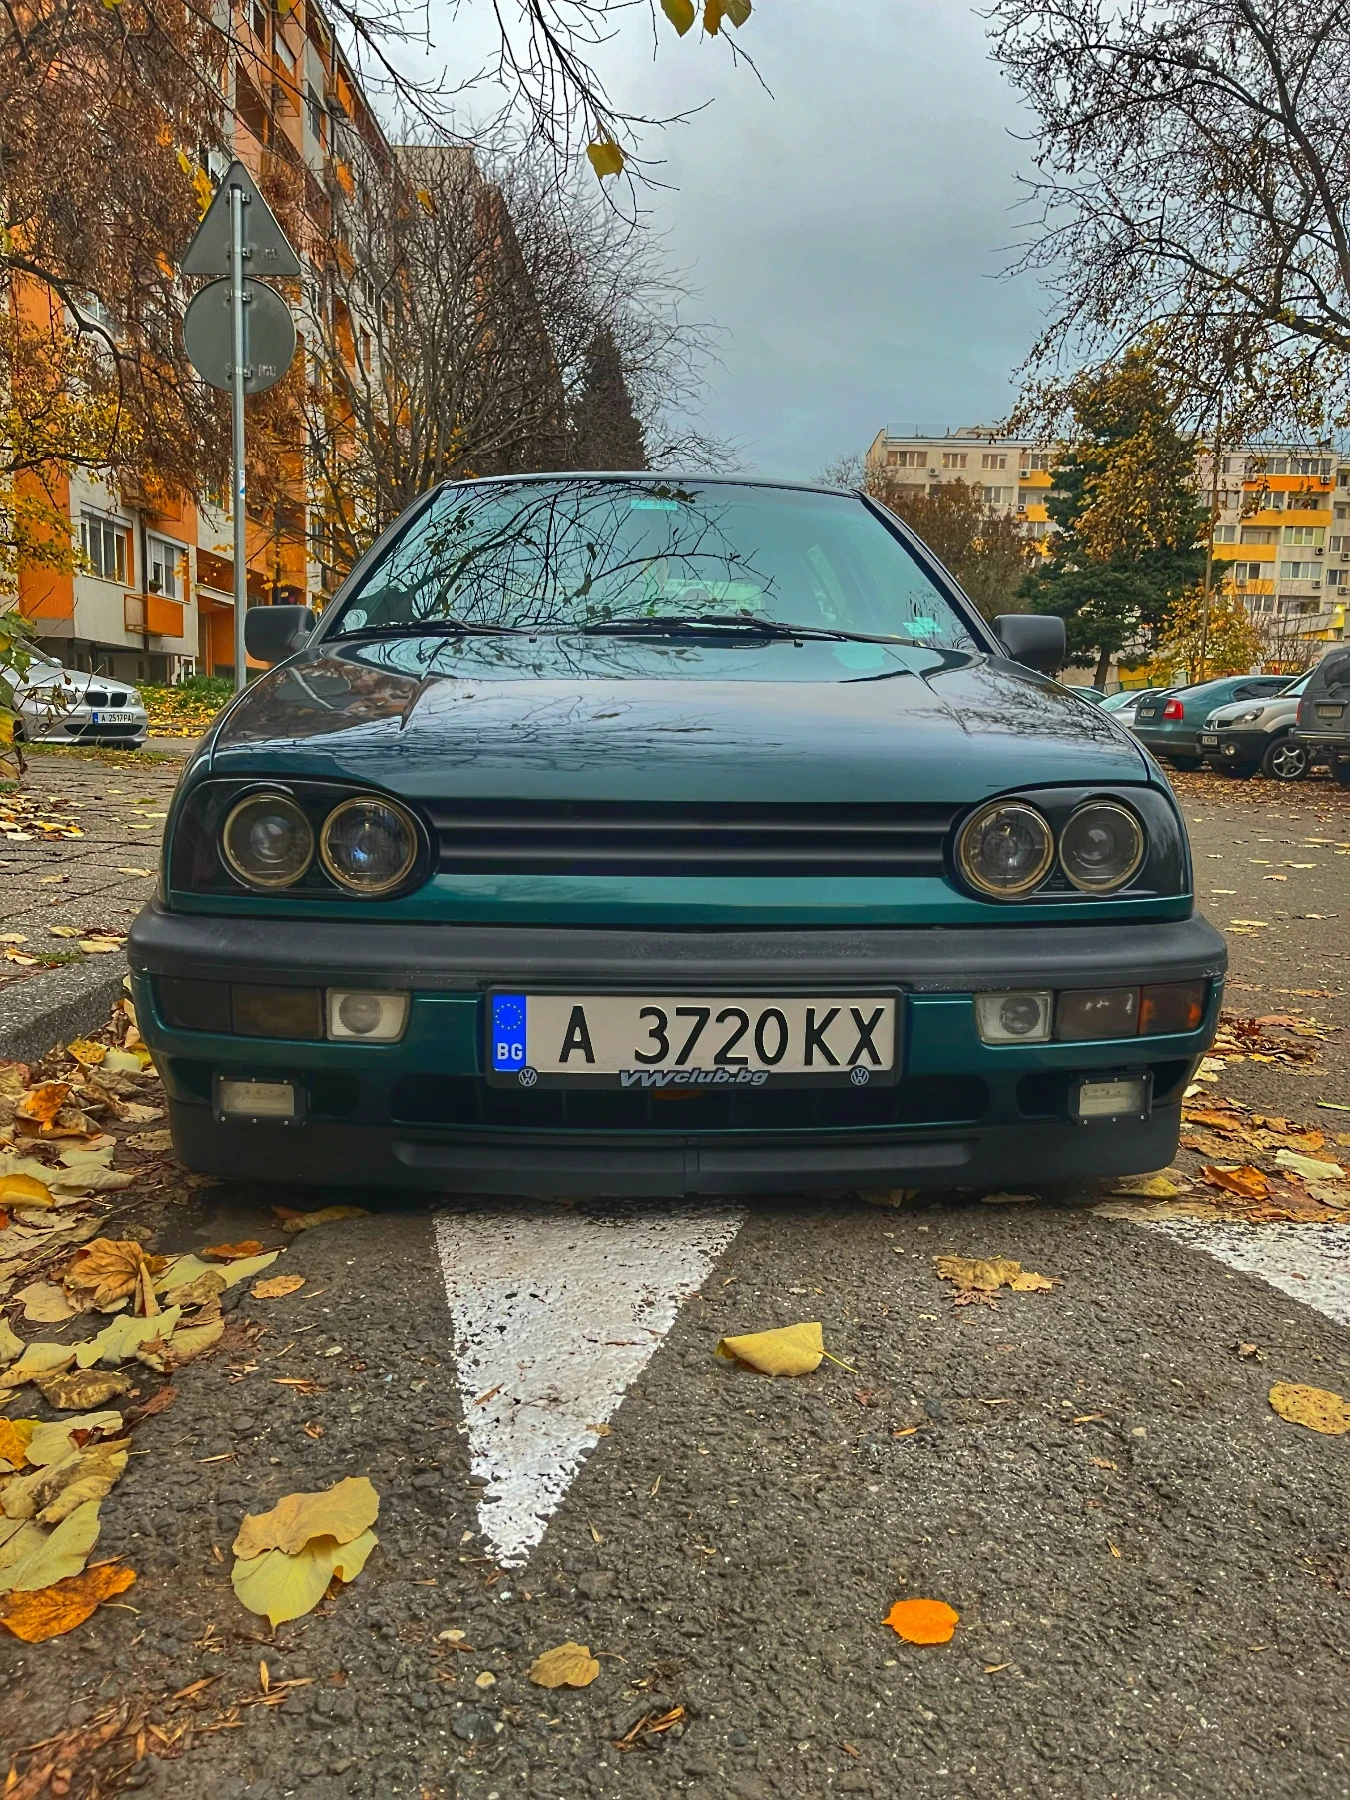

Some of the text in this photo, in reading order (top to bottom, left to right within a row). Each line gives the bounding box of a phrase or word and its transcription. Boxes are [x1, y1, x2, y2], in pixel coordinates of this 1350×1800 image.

[496, 1042, 523, 1060] BG
[558, 1004, 885, 1066] A 3720 KX
